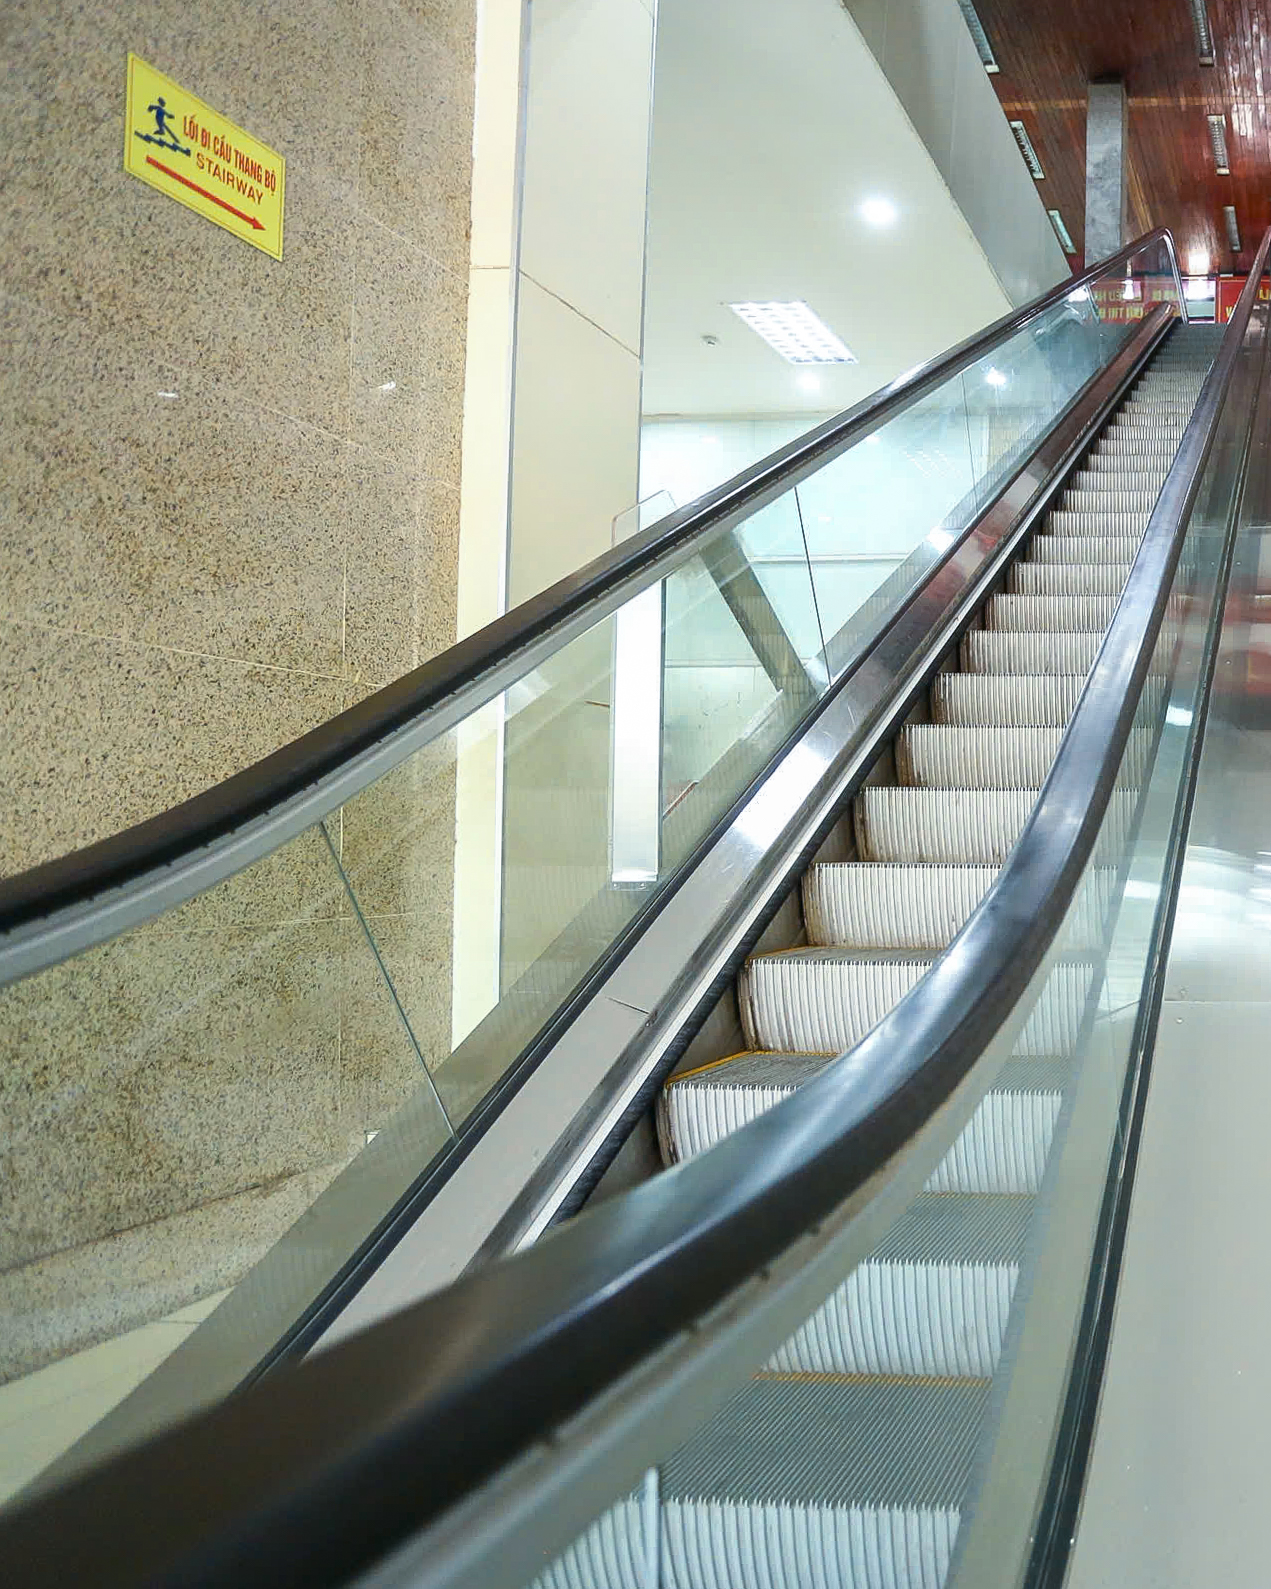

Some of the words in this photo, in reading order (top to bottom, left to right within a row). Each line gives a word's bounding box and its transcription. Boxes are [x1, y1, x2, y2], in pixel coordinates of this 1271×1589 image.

[183, 113, 199, 142] LỐI
[234, 149, 263, 184] THANG
[196, 152, 264, 205] STAIRWAY
